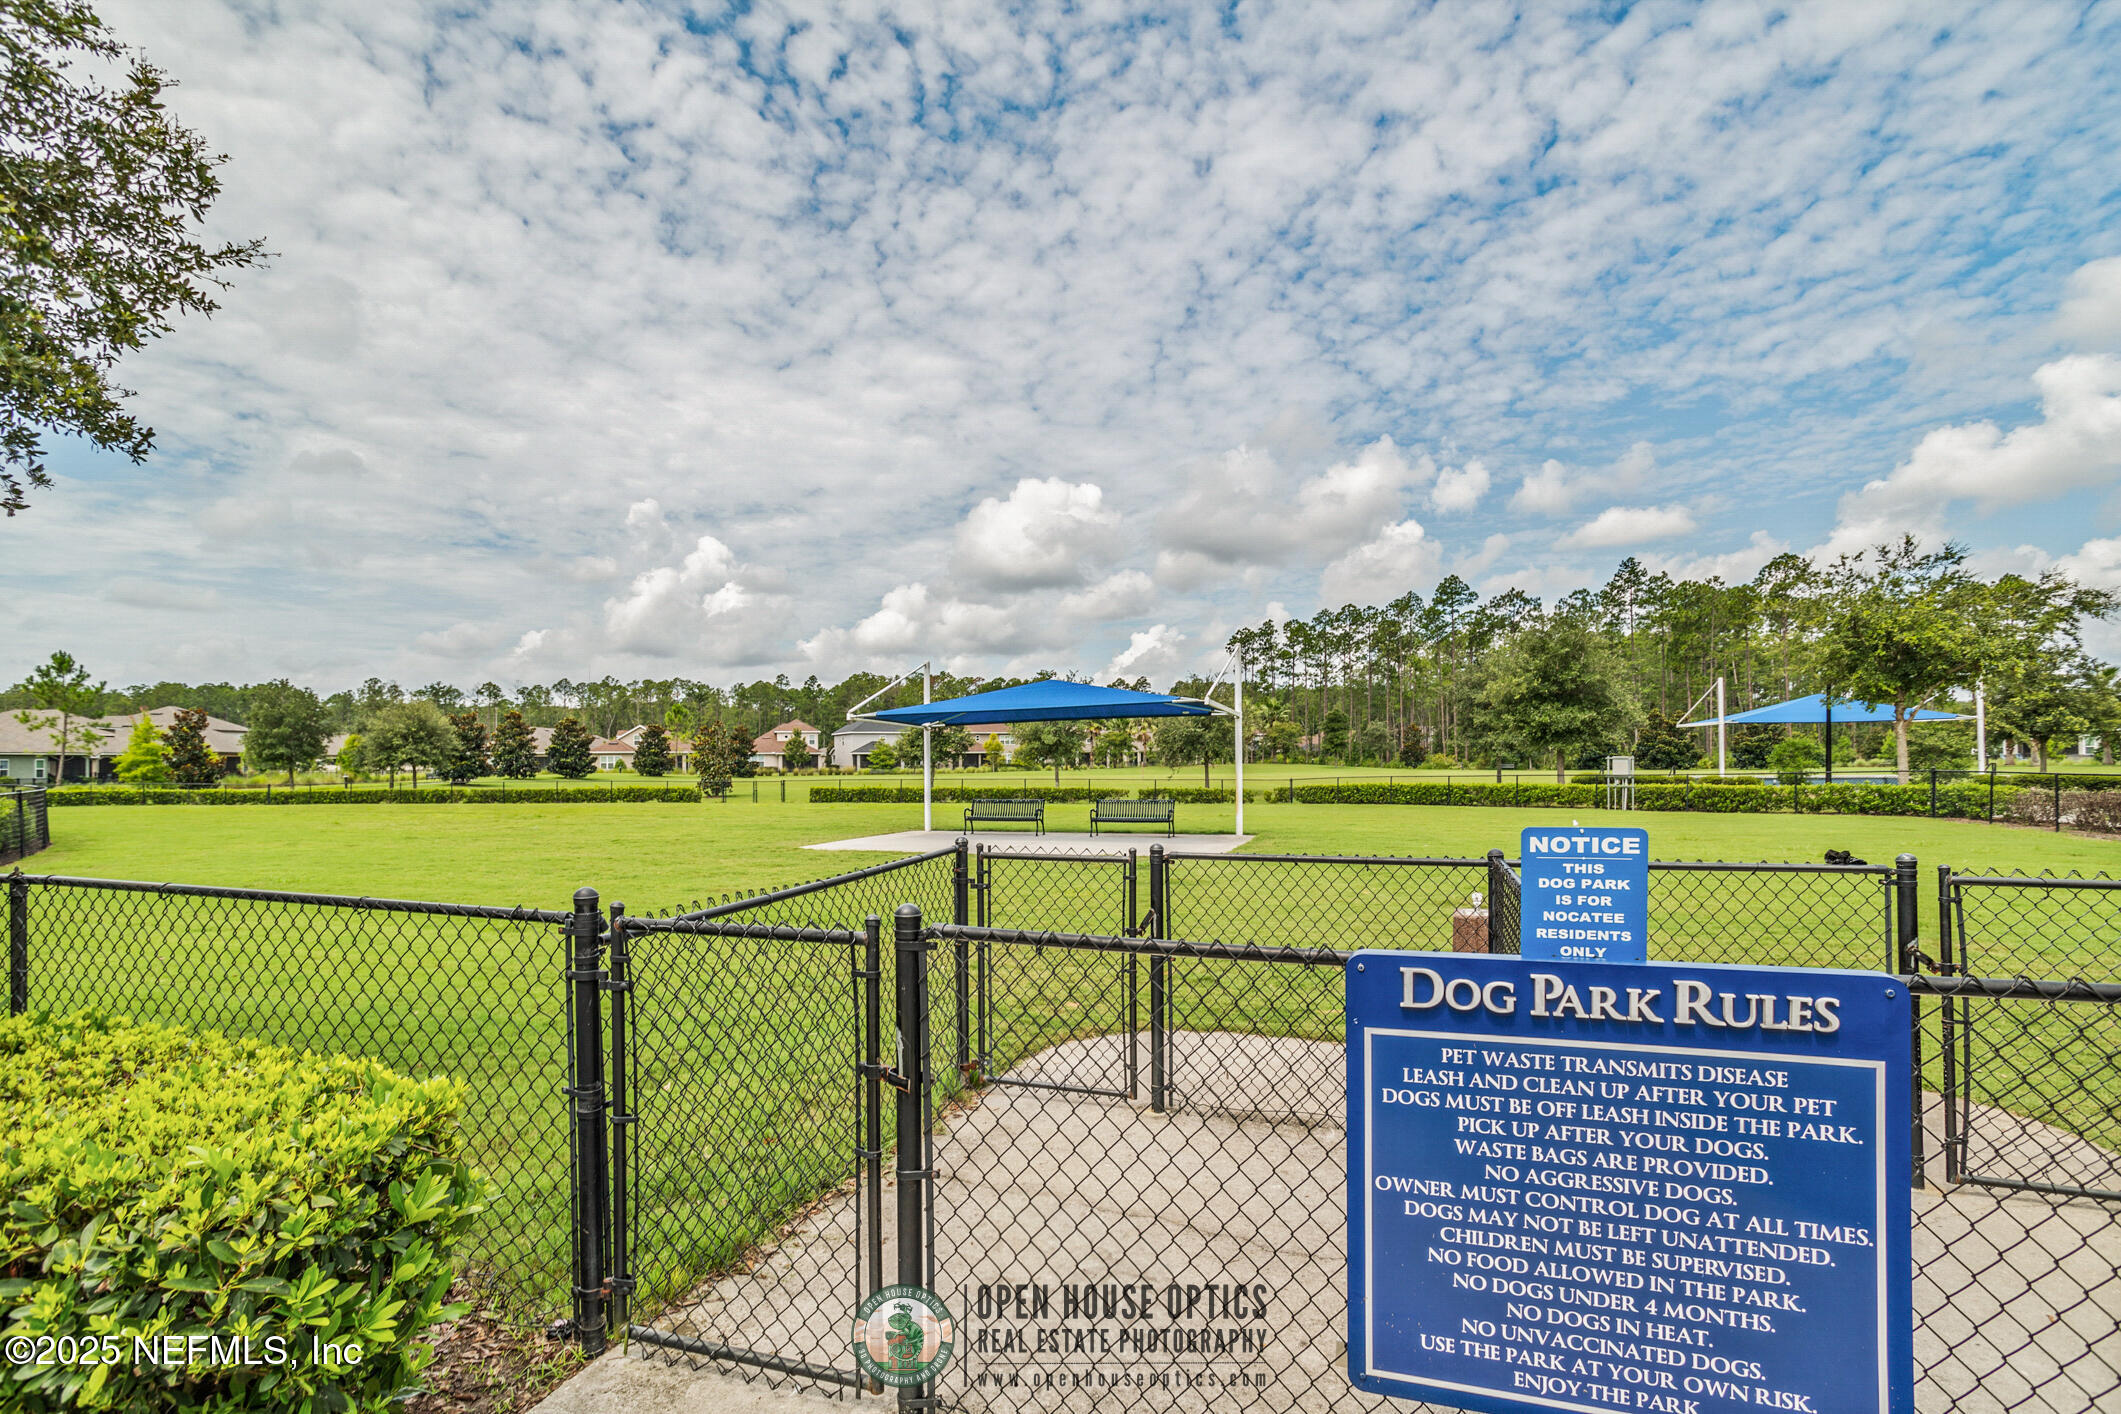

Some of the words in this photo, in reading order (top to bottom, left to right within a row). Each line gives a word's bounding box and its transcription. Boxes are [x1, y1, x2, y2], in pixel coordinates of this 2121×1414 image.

[1529, 836, 1641, 854] NOTICE
[1538, 878, 1576, 889] DOG
[1581, 879, 1631, 890] PARK
[1562, 863, 1605, 874] THIS
[1543, 911, 1625, 924] NOCATEE
[1555, 895, 1572, 905] IS
[1577, 895, 1613, 907] FOR
[1536, 928, 1632, 942] RESIDENTS
[1560, 946, 1607, 958] ONLY
[1441, 1048, 1477, 1065] PET
[1481, 1051, 1555, 1070] WASTE
[1560, 1056, 1692, 1080] TRANSMITS
[1698, 1066, 1788, 1088] DISEASE
[1403, 1067, 1464, 1087] LEASH
[1469, 1073, 1518, 1090] AND
[1523, 1076, 1595, 1097] CLEAN
[1600, 1082, 1629, 1099] UP
[1634, 1085, 1708, 1106] AFTER
[1713, 1091, 1787, 1112] YOUR
[1793, 1097, 1837, 1116] PET
[1382, 1088, 1440, 1107] DOGS
[1445, 1093, 1504, 1112] MUST
[1509, 1098, 1532, 1115] BE
[1537, 1101, 1576, 1118] OFF
[1582, 1104, 1649, 1125] LEASH
[1654, 1110, 1728, 1132] INSIDE
[1734, 1117, 1781, 1137] THE
[1787, 1121, 1863, 1144] PARK.
[1458, 1116, 1507, 1136] PICK
[1512, 1121, 1539, 1138] UP
[1544, 1124, 1614, 1145] AFTER
[1619, 1131, 1689, 1152] YOUR
[1695, 1138, 1769, 1160] DOGS.
[1454, 1138, 1526, 1160] WASTE
[1532, 1146, 1587, 1166] BAGS
[1592, 1152, 1637, 1171] ARE
[1643, 1156, 1773, 1185] PROVIDED.
[1485, 1164, 1520, 1182] NO
[1524, 1168, 1659, 1197] AGGRESSIVE
[1665, 1182, 1737, 1206] DOGS.
[1375, 1175, 1456, 1198] OWNER
[1460, 1184, 1521, 1205] MUST
[1525, 1191, 1639, 1218] CONTROL
[1644, 1204, 1700, 1225] DOG
[1706, 1211, 1740, 1230] AT
[1745, 1216, 1789, 1236] ALL
[1794, 1221, 1874, 1247] TIMES.
[1404, 1200, 1463, 1221] DOGS
[1467, 1207, 1518, 1227] MAY
[1523, 1214, 1573, 1234] NOT
[1578, 1220, 1602, 1238] BE
[1607, 1223, 1656, 1244] LEFT
[1661, 1230, 1836, 1267] UNATTENDED.
[1440, 1227, 1549, 1254] CHILDREN
[1554, 1240, 1617, 1262] MUST
[1622, 1248, 1646, 1266] BE
[1652, 1252, 1791, 1286] SUPERVISED.
[1428, 1247, 1462, 1265] NO
[1467, 1252, 1529, 1274] FOOD
[1534, 1261, 1644, 1289] ALLOWED
[1649, 1275, 1675, 1294] IN
[1680, 1280, 1726, 1301] THE
[1732, 1286, 1806, 1313] PARK.
[1453, 1272, 1487, 1291] NO
[1492, 1277, 1554, 1301] DOGS
[1559, 1286, 1639, 1313] UNDER
[1644, 1299, 1658, 1315] 4
[1663, 1301, 1776, 1333] MONTHS.
[1506, 1302, 1542, 1321] NO
[1547, 1308, 1610, 1332] DOGS
[1616, 1318, 1641, 1336] IN
[1646, 1322, 1713, 1348] HEAT.
[1461, 1318, 1496, 1337] NO
[1501, 1324, 1686, 1366] UNVACCINATED
[1692, 1353, 1766, 1381] DOGS.
[1420, 1333, 1455, 1354] USE
[1460, 1340, 1500, 1361] THE
[1506, 1347, 1566, 1372] PARK
[1571, 1358, 1603, 1377] AT
[1607, 1363, 1678, 1390] YOUR
[1683, 1376, 1749, 1402] OWN
[1755, 1387, 1817, 1414] RISK.
[1514, 1371, 1582, 1397] ENJOY
[1587, 1383, 1630, 1405] THE
[1636, 1391, 1700, 1414] PARK
